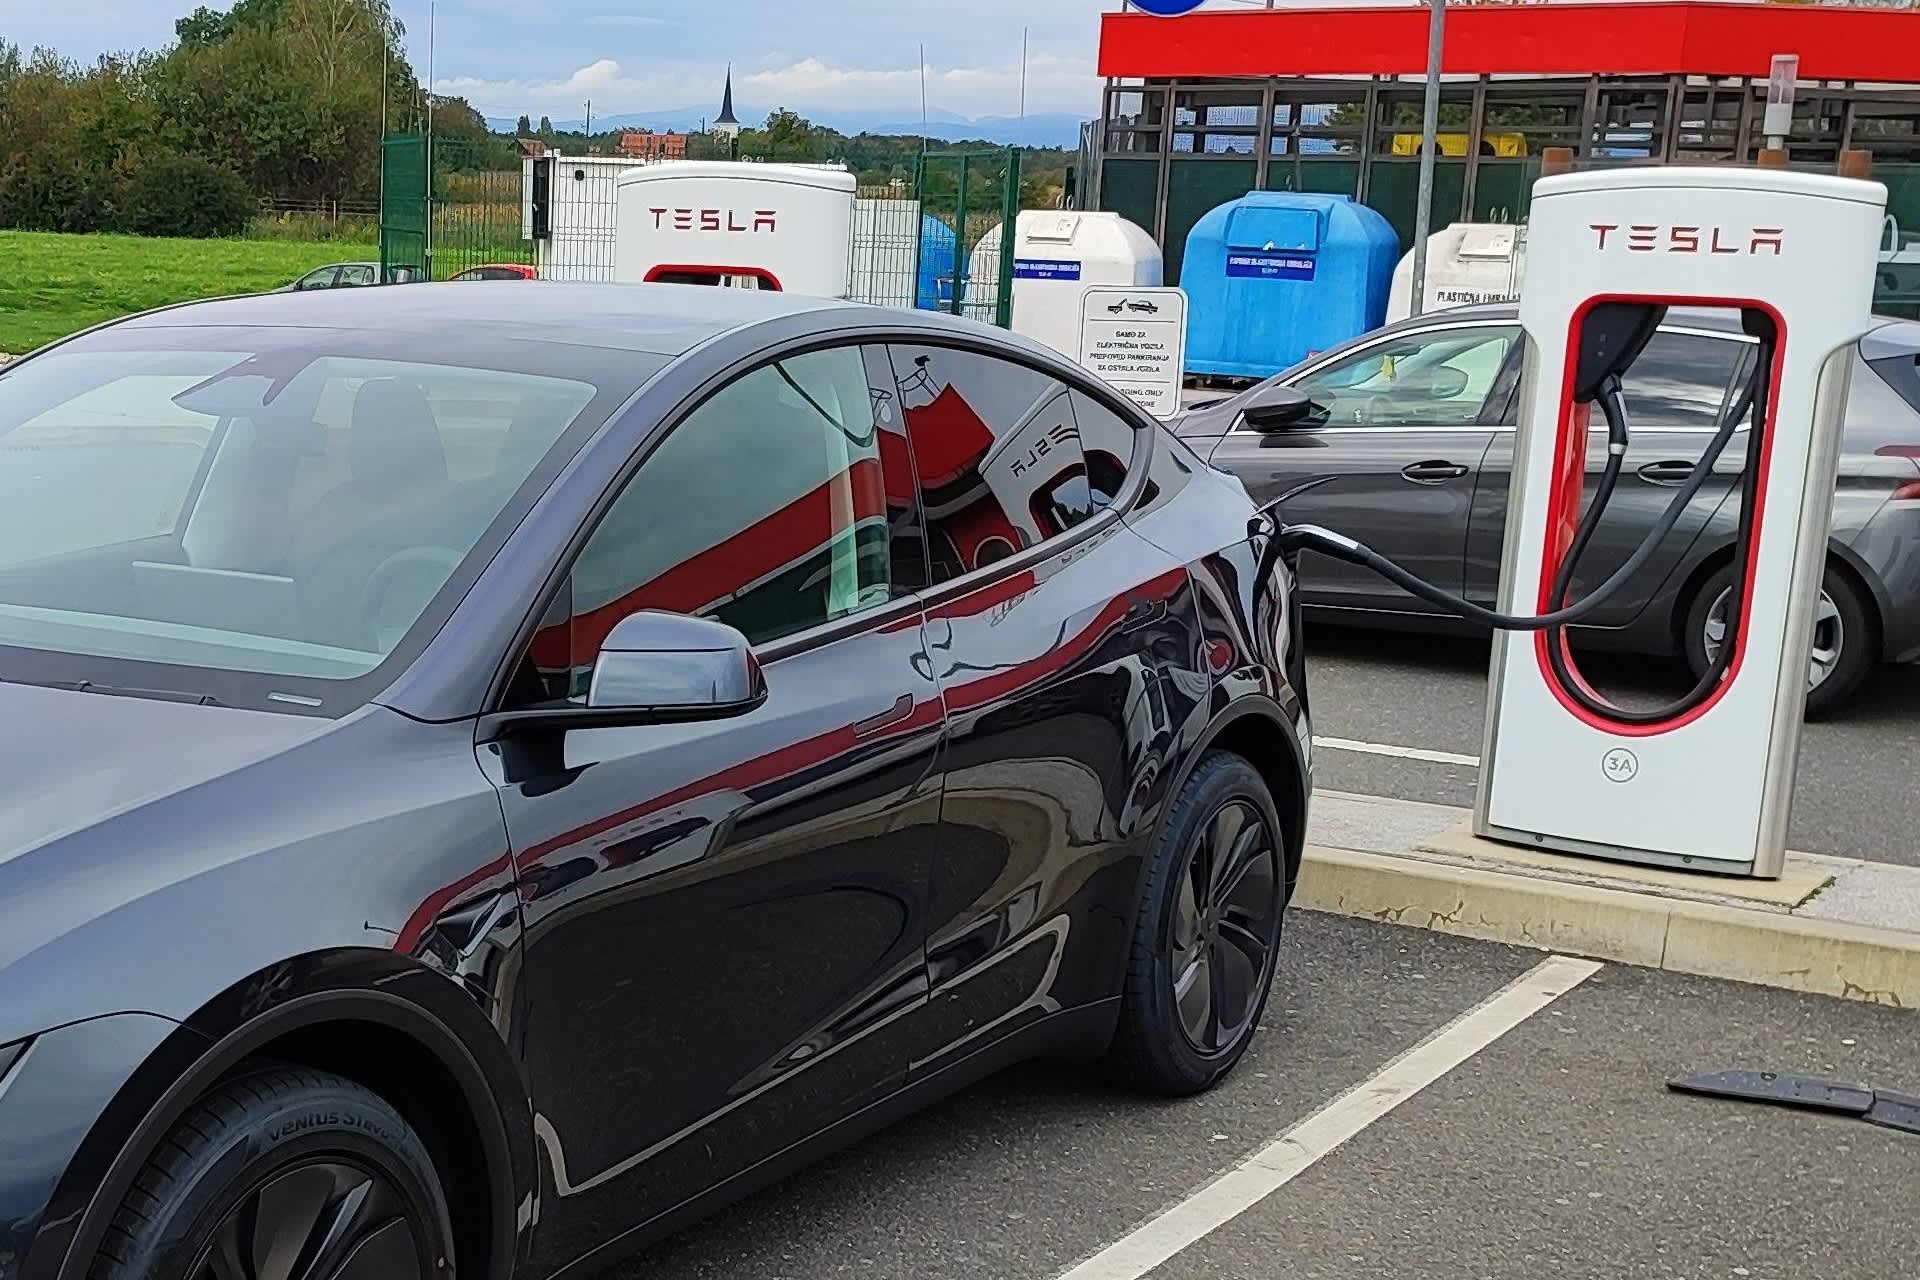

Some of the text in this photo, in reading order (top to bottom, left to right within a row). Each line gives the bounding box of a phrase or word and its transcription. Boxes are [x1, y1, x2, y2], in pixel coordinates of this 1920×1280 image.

[648, 207, 777, 232] TESLA
[1588, 224, 1784, 256] TESLA
[1608, 757, 1633, 773] 3A
